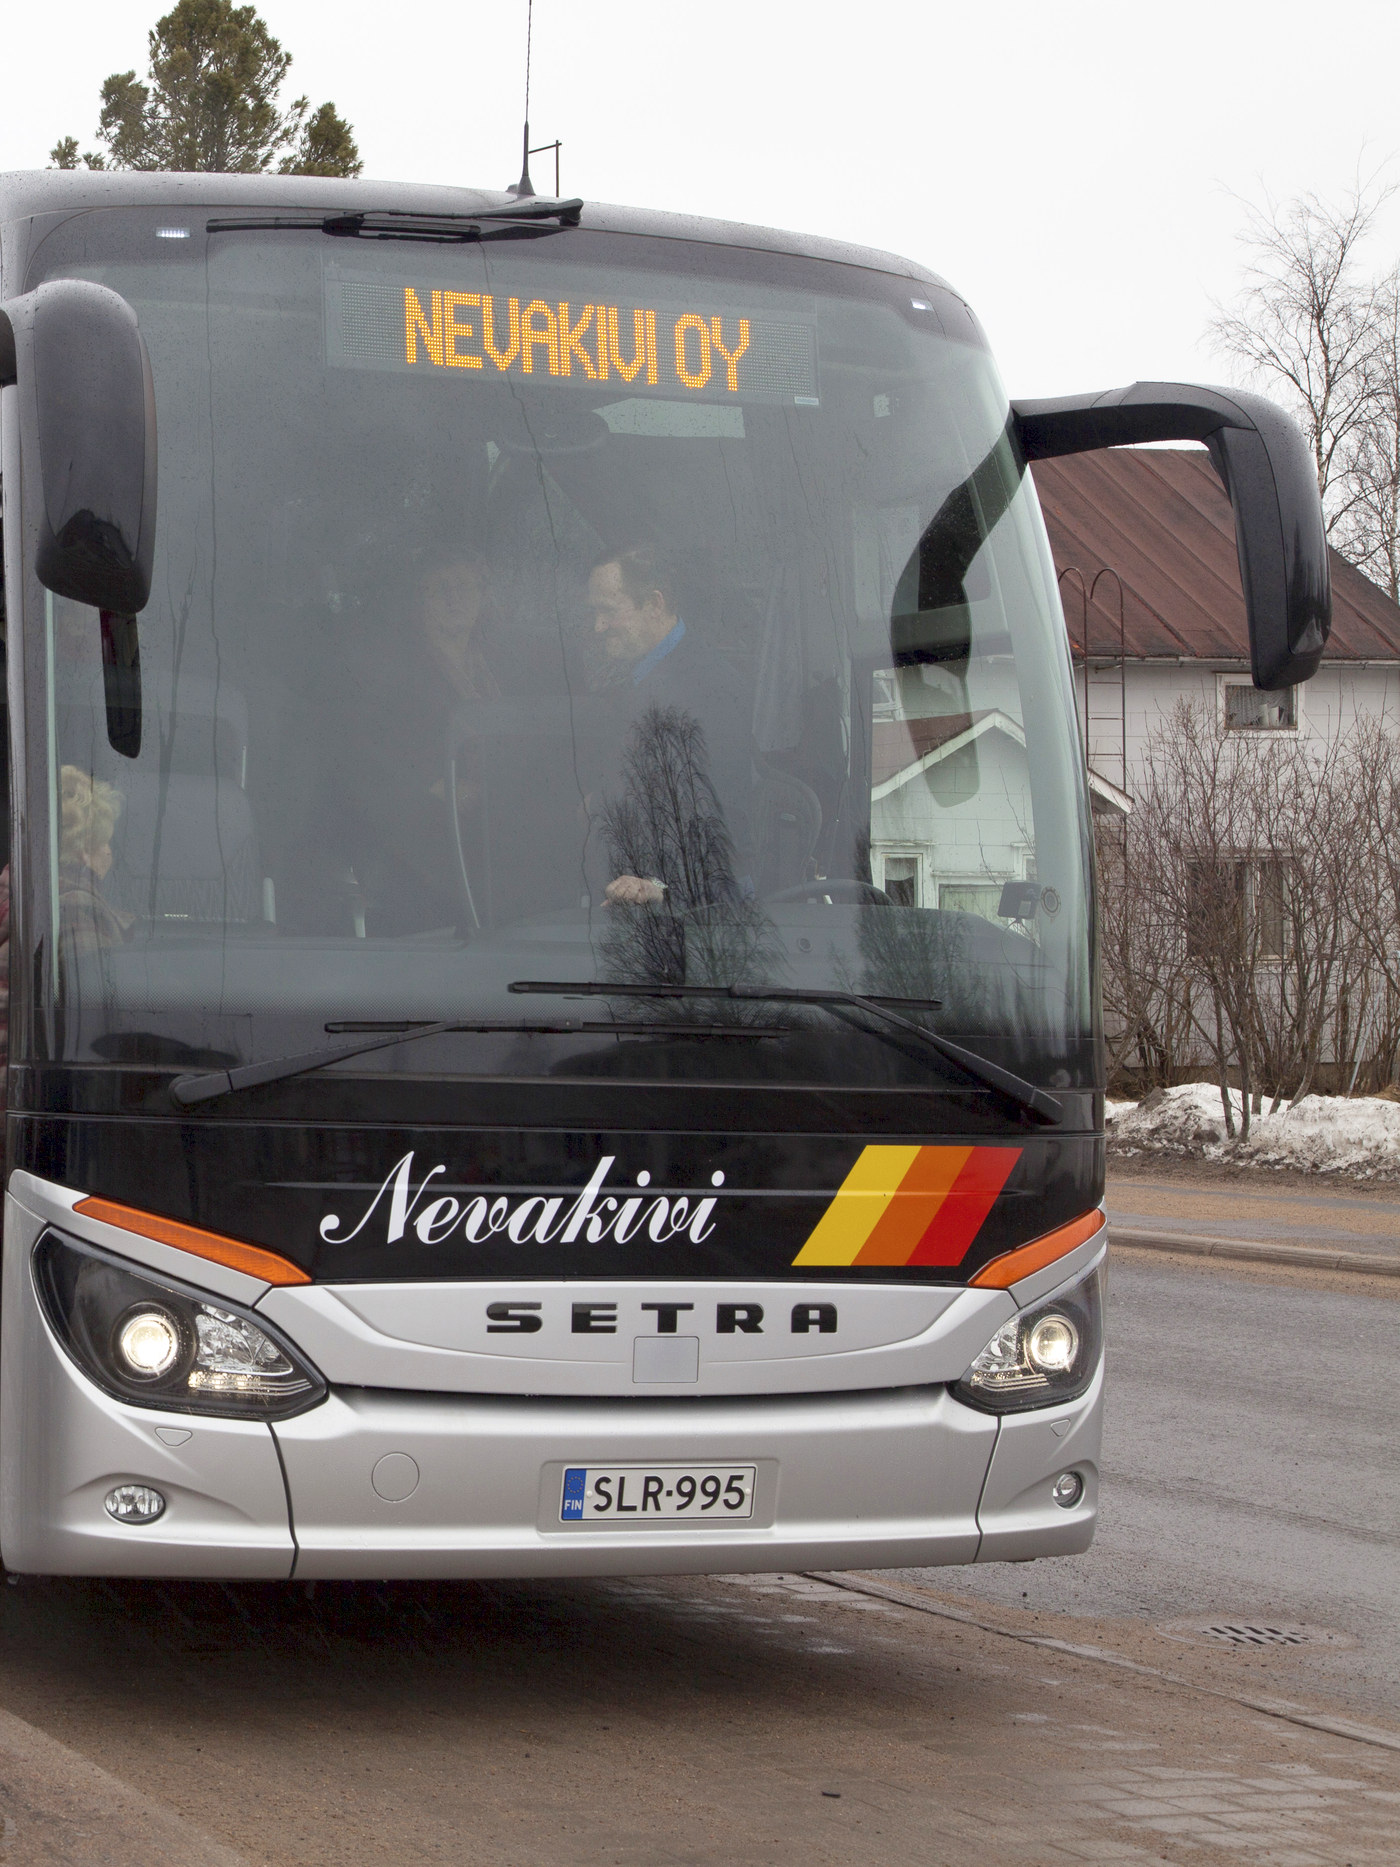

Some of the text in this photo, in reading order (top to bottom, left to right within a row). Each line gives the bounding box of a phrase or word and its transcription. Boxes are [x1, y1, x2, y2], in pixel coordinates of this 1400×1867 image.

[404, 287, 751, 392] NEVAKIVI OY
[320, 1150, 726, 1245] Nevakivi
[486, 1302, 839, 1335] SETRA
[564, 1474, 746, 1512] FIN SLR-995
